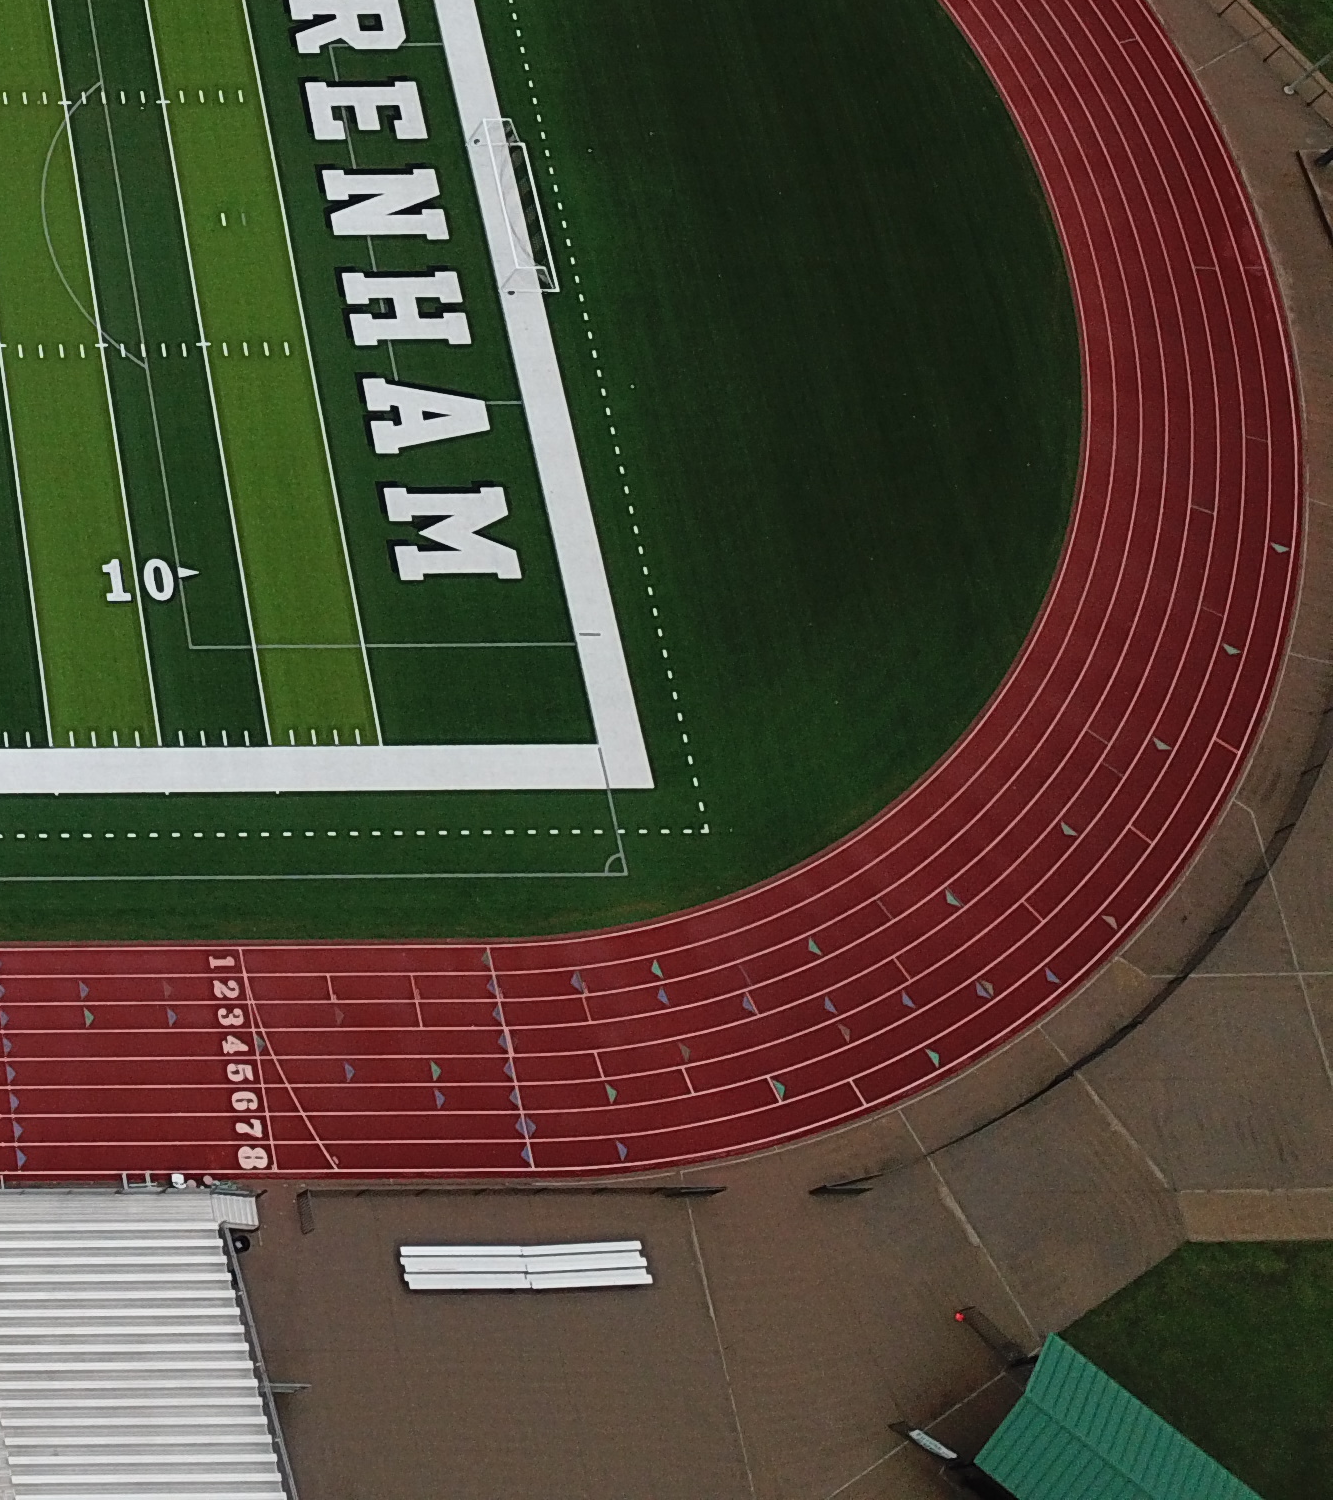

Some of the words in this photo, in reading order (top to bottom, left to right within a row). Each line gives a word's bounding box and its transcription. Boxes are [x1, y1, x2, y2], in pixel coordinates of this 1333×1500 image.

[103, 559, 176, 601] 10
[209, 956, 234, 968] 1
[213, 980, 239, 998] 2
[218, 1008, 244, 1026] 3
[222, 1035, 248, 1054] 4
[227, 1063, 253, 1082] 5
[232, 1091, 258, 1110] 6
[236, 1119, 262, 1138] 7
[238, 1146, 268, 1169] 8
